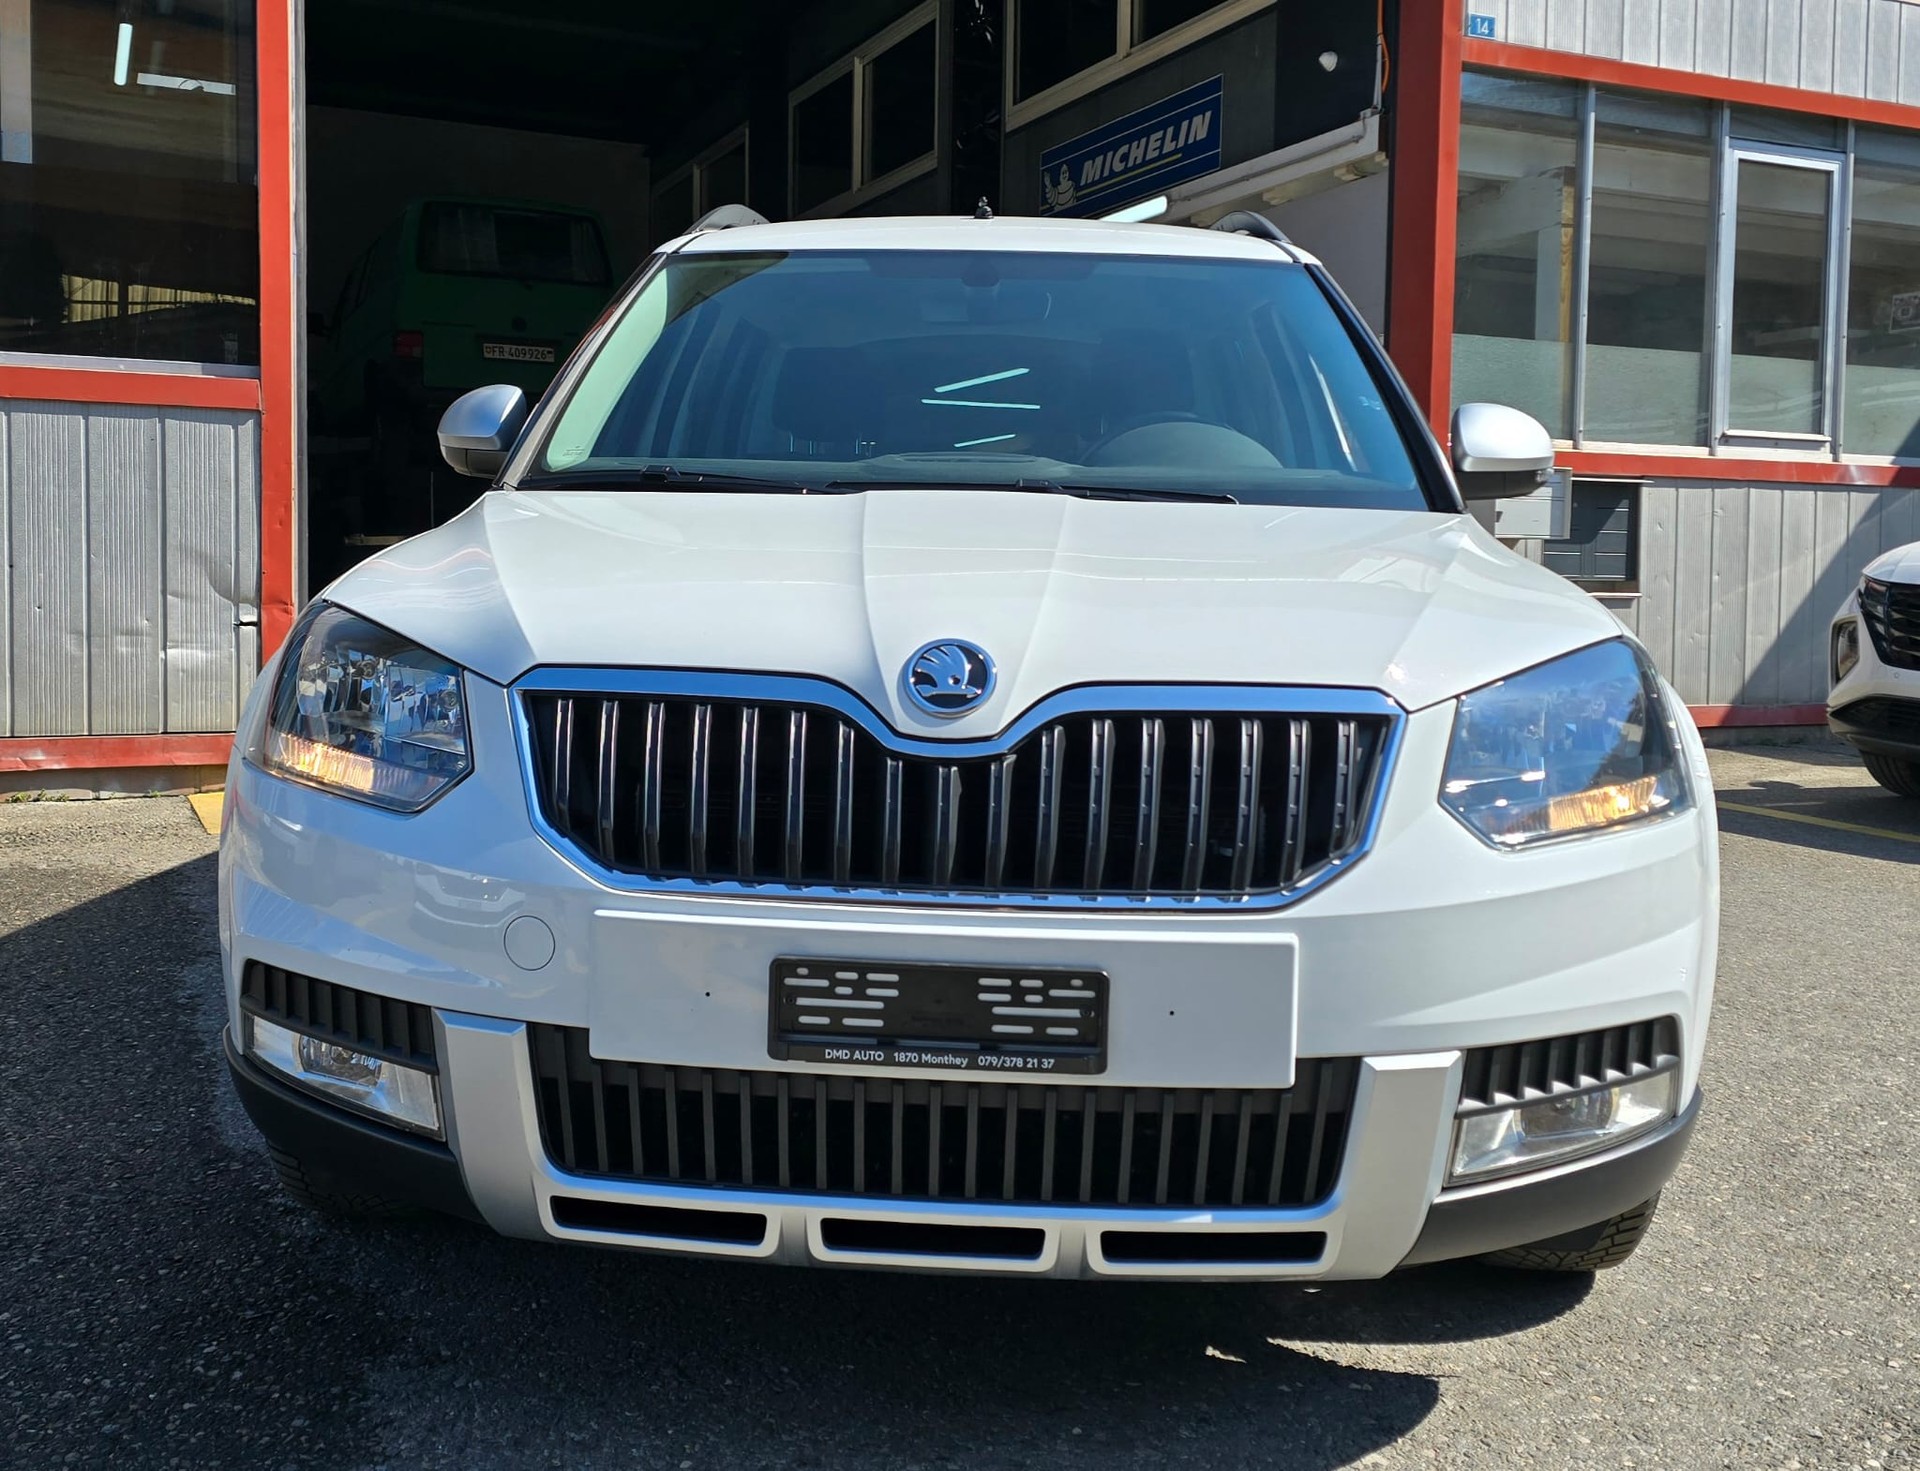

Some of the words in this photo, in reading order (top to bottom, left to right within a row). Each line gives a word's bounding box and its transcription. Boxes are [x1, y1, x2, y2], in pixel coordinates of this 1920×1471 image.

[1476, 18, 1489, 35] 14
[1079, 110, 1212, 187] MICHELIN
[825, 1049, 850, 1060] DMD
[853, 1050, 884, 1061] AUTO
[893, 1052, 919, 1063] 1870
[921, 1053, 969, 1068] Monthey
[977, 1055, 1023, 1068] 079/378
[1026, 1058, 1038, 1068] 21
[1041, 1058, 1055, 1069] 37
